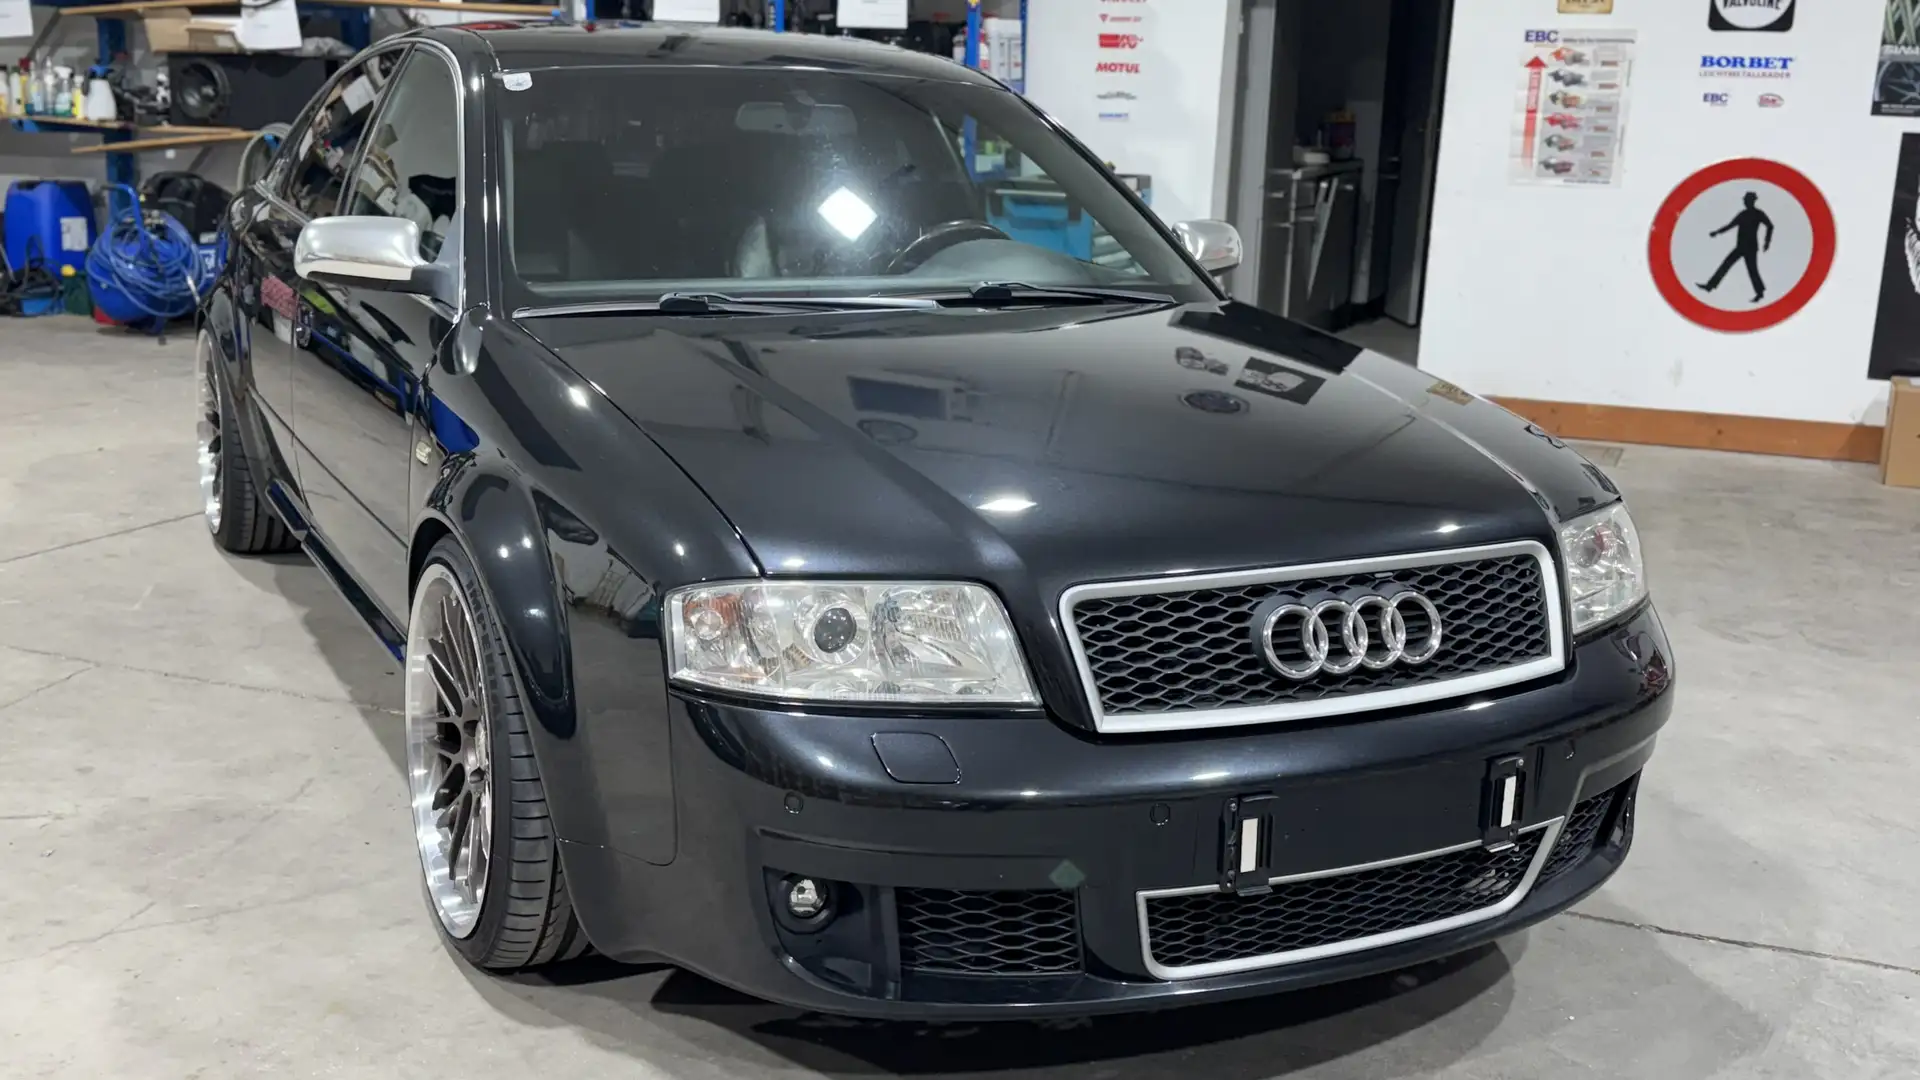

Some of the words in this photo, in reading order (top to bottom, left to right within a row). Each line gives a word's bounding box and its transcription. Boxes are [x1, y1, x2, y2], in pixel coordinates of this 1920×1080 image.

[1524, 29, 1559, 43] EBC
[1096, 62, 1140, 73] MOTUL
[1700, 55, 1793, 69] BORBET
[1703, 93, 1728, 103] EBC
